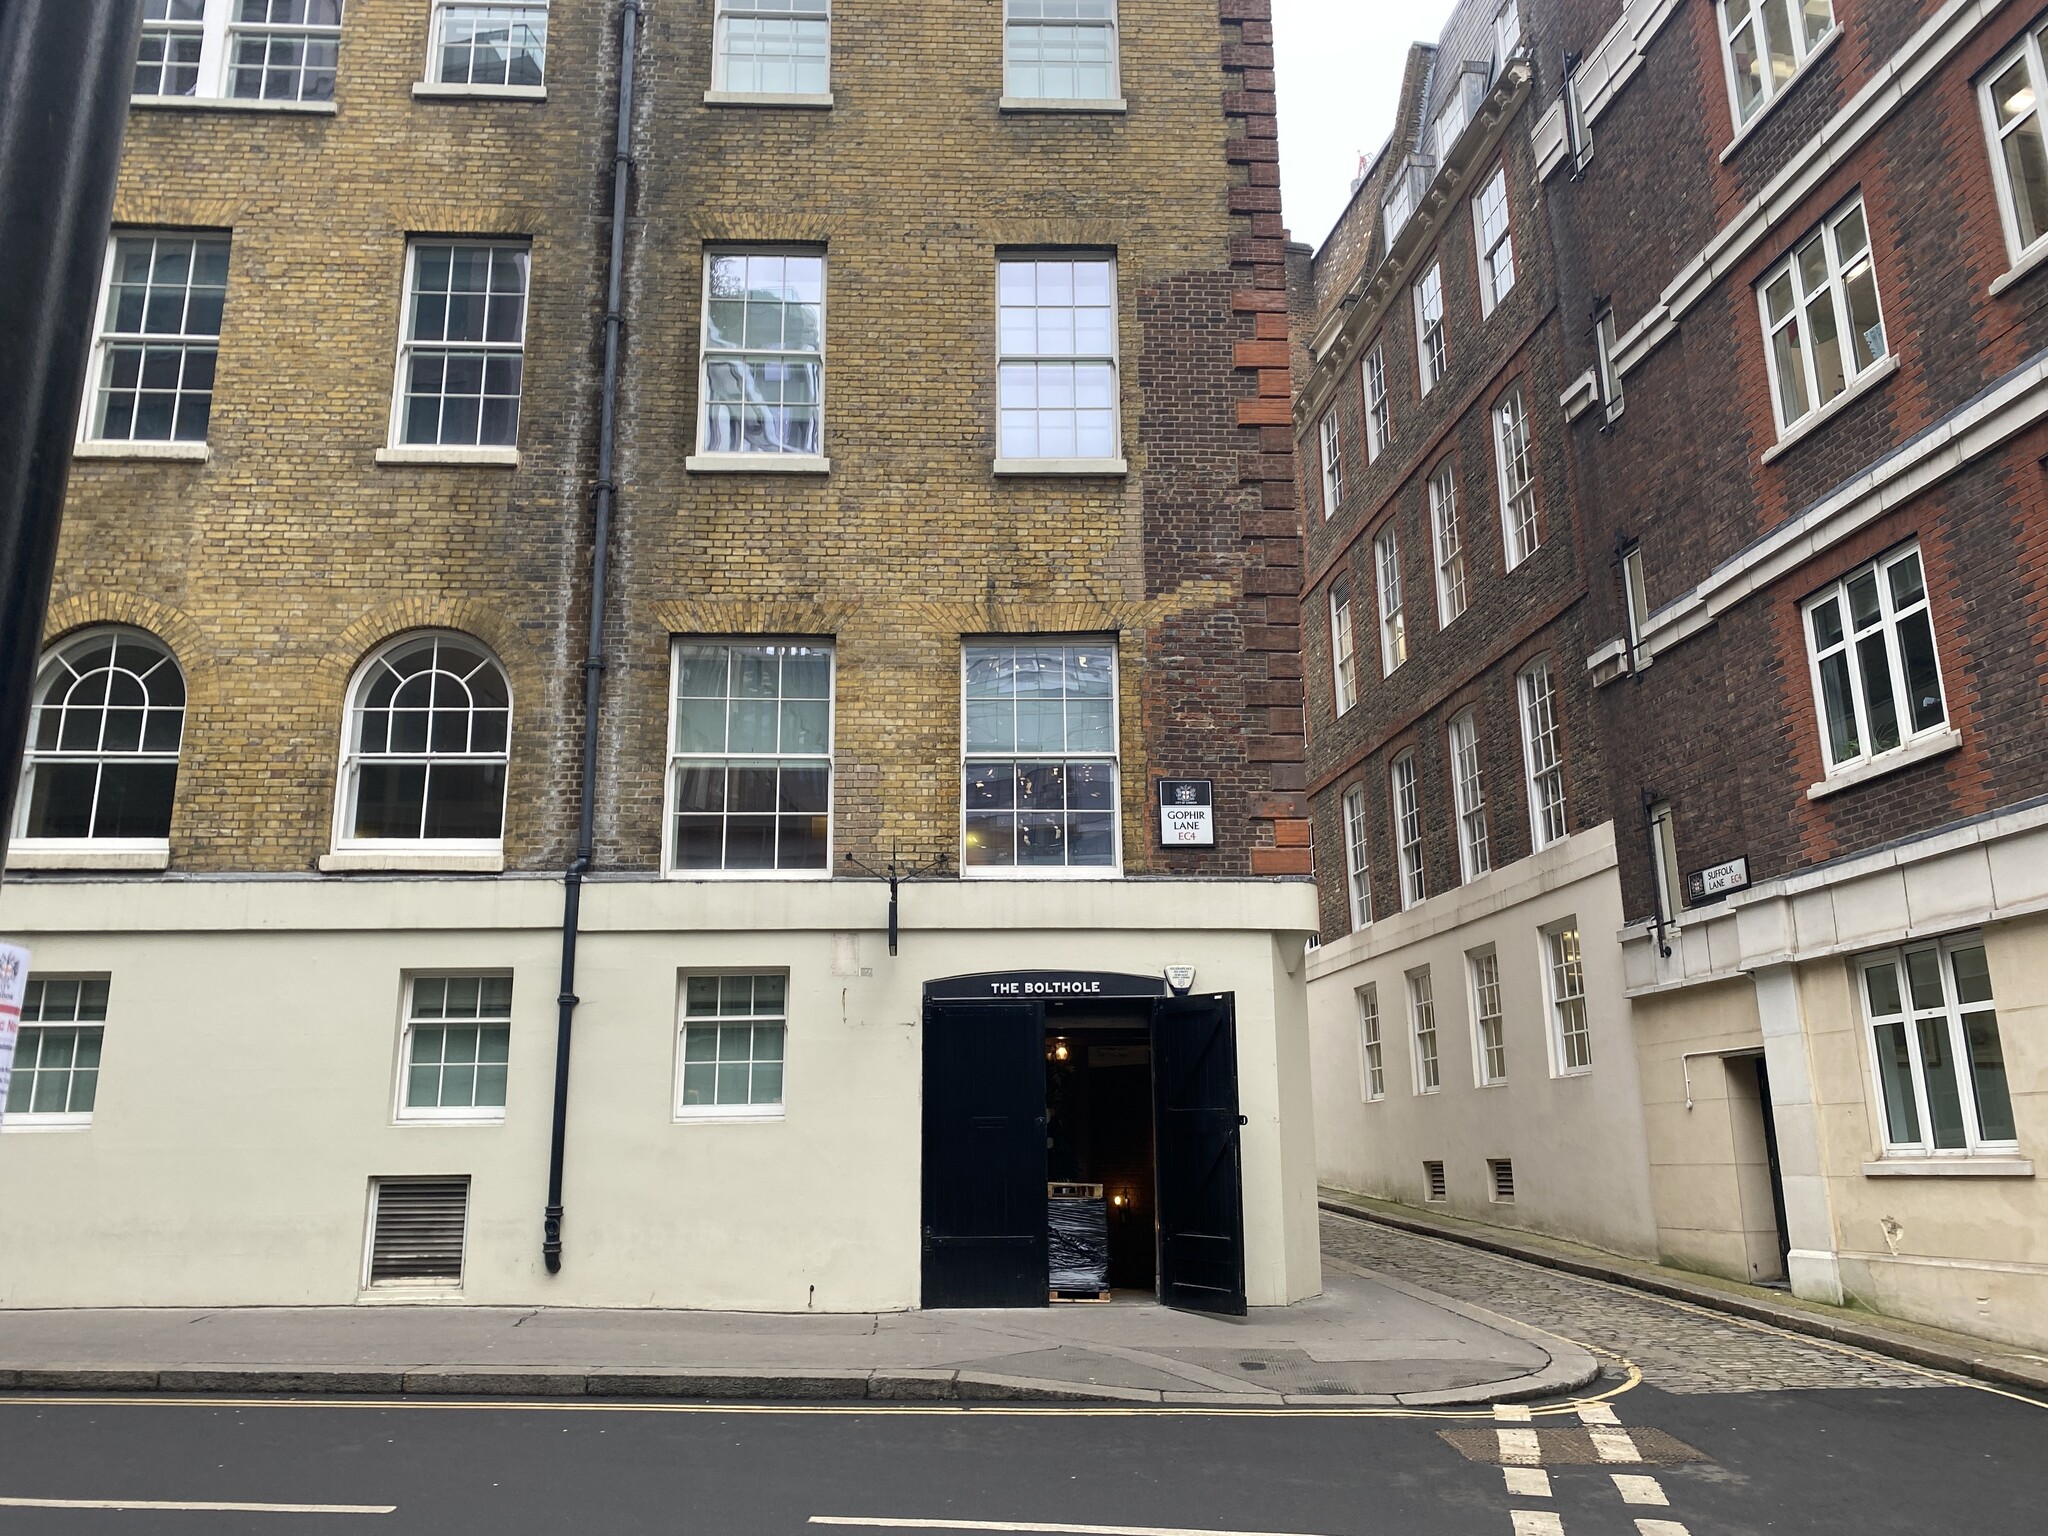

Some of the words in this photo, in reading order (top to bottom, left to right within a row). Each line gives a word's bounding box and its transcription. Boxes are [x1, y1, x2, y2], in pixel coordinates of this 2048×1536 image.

[1167, 811, 1205, 819] GOPHIR
[1174, 821, 1199, 830] LANE
[1178, 832, 1196, 840] EC4
[1708, 865, 1734, 880] SUFFOLK
[1708, 879, 1725, 890] LANE
[1730, 873, 1742, 884] EC4
[991, 982, 1019, 994] THE
[1024, 981, 1101, 994] BOLTHOLE
